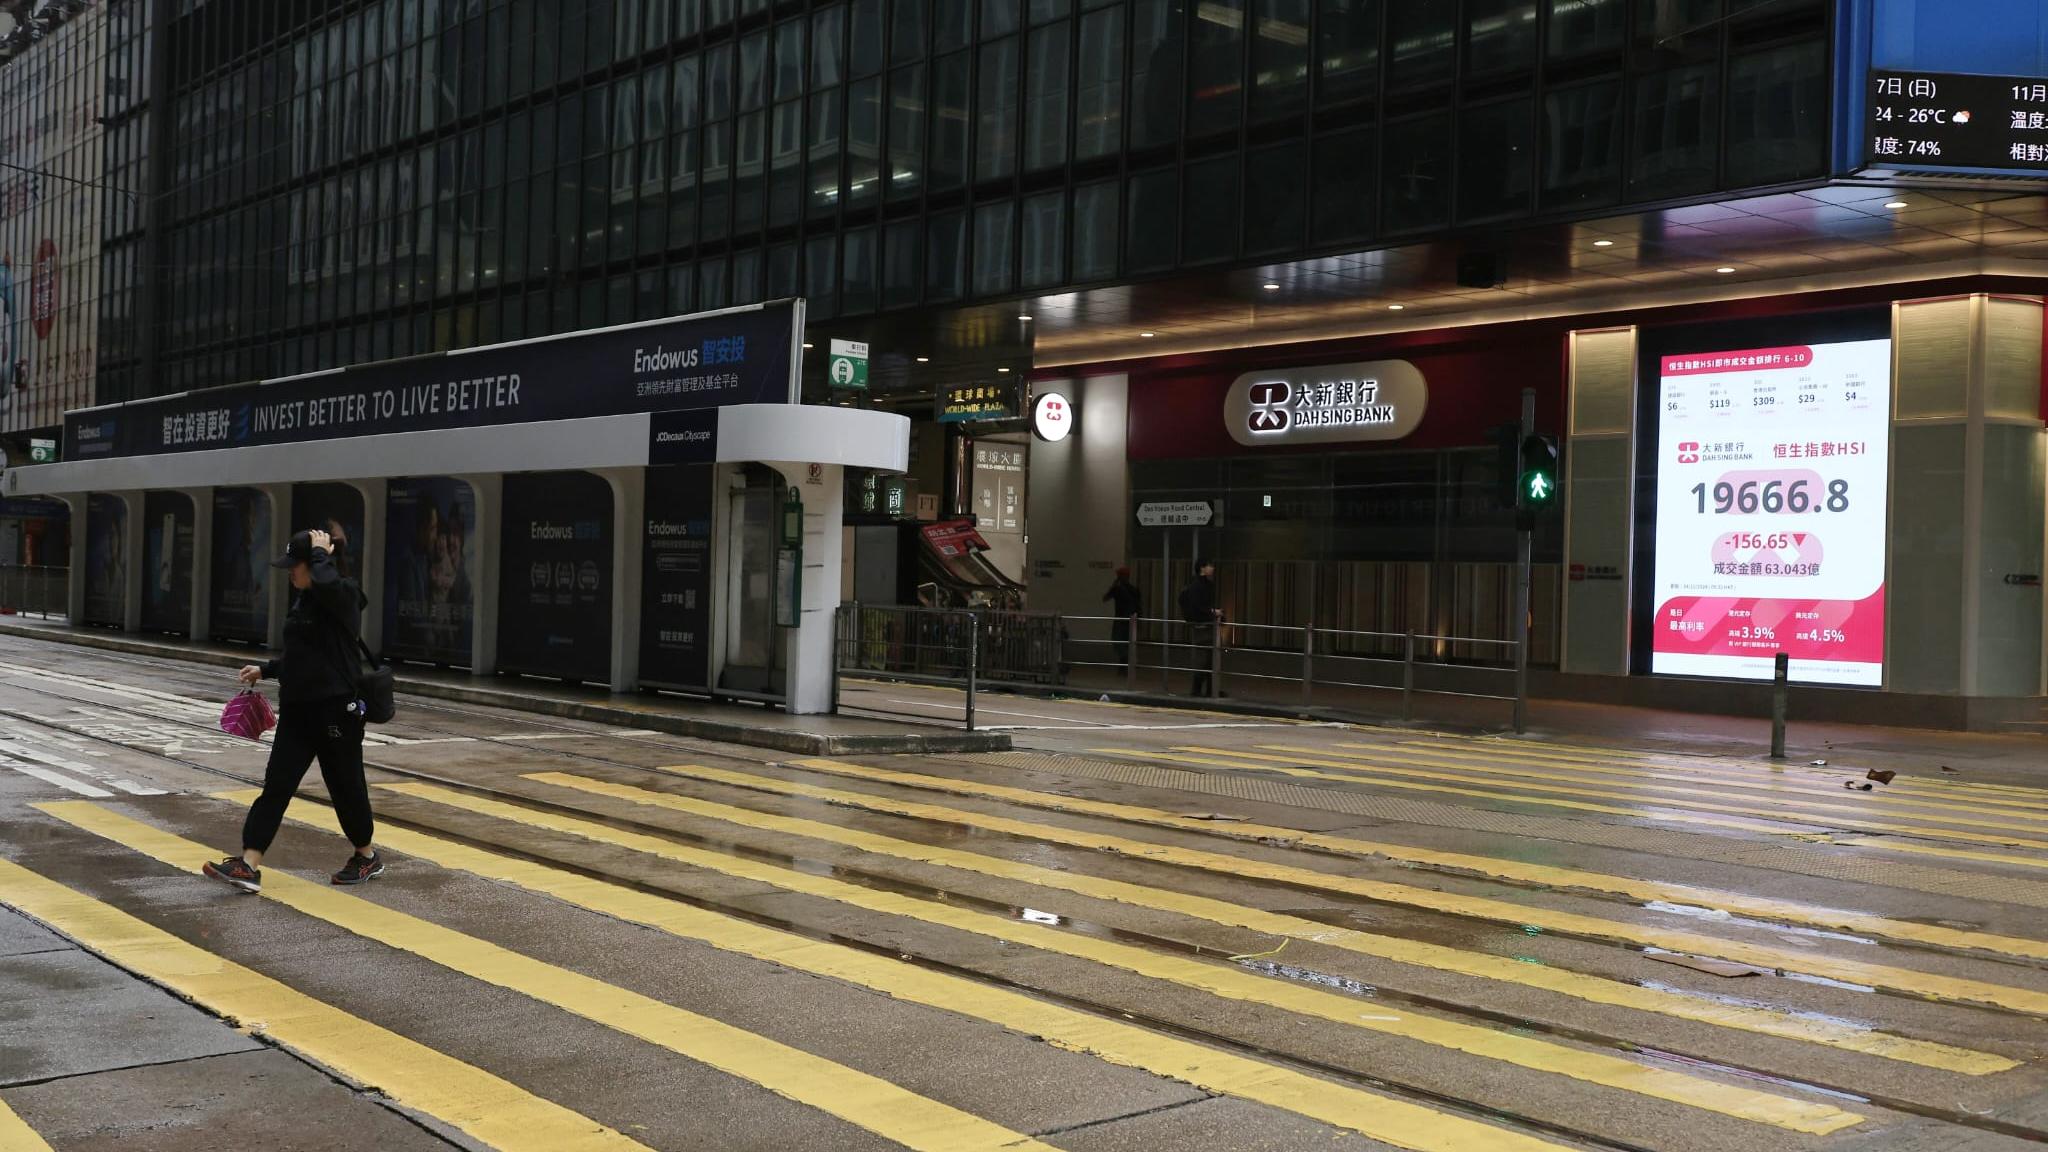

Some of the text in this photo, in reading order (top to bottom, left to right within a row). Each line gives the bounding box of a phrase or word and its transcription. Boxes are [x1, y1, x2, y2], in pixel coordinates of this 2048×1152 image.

[1876, 78, 1936, 98] 7日 (日)
[2012, 85, 2046, 102] 11月
[1908, 108, 1946, 124] 26°C
[2010, 110, 2048, 129] 溫度
[1908, 140, 1941, 156] 74%
[633, 335, 746, 374] Endowus 智安投
[1784, 354, 1805, 363] 6-10
[1295, 381, 1376, 406] 大新銀行
[1798, 394, 1815, 404] $29
[1845, 391, 1857, 401] $4
[254, 374, 521, 432] INVEST BETTER TO LIVE BETTER
[1667, 401, 1678, 411] $6
[1709, 399, 1730, 409] $119
[1753, 396, 1775, 407] $309
[1294, 407, 1392, 426] DAH SING BANK
[162, 409, 231, 445] 智在投資更好
[684, 428, 711, 442] Cityscape
[1703, 442, 1745, 453] 大新銀行
[1773, 441, 1865, 459] 恒生指數HSI
[1702, 454, 1717, 462] DAH
[1734, 453, 1753, 461] BANK
[1690, 479, 1849, 515] 19666.8
[1186, 503, 1205, 511] Central
[531, 520, 573, 539] Endowus
[648, 520, 687, 535] Endowus
[1725, 533, 1788, 549] -156.65
[1713, 562, 1820, 576] 成交金額 63.043億
[1669, 620, 1705, 632] 最高利率
[1742, 626, 1775, 640] 3.9%
[1809, 629, 1845, 643] 4.5%
